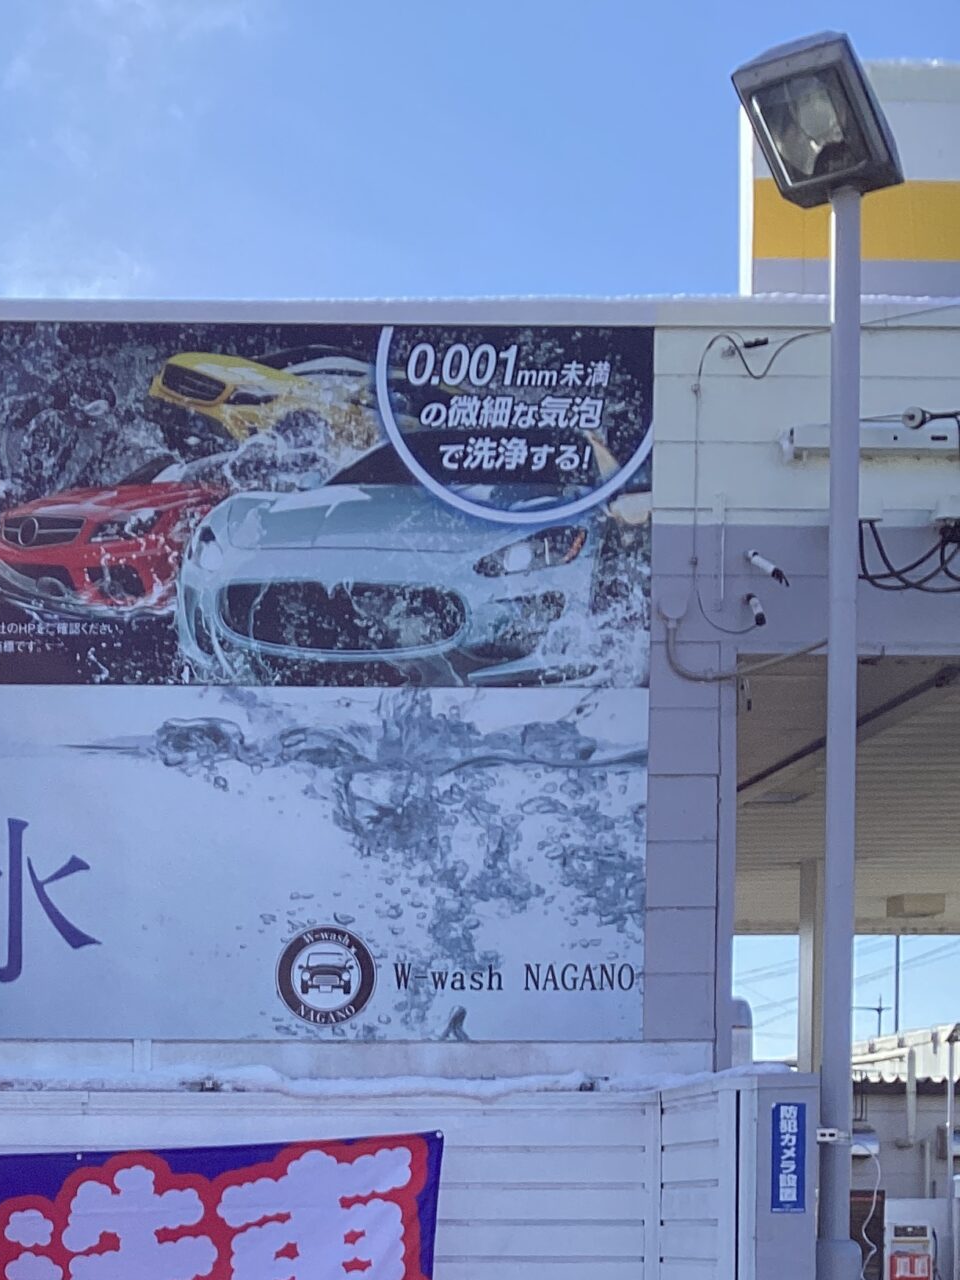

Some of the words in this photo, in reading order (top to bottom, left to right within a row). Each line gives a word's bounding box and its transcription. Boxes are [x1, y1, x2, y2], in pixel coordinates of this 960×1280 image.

[420, 395, 606, 429] の微細な気泡
[393, 962, 504, 992] W-wash
[524, 963, 636, 992] NAGANO
